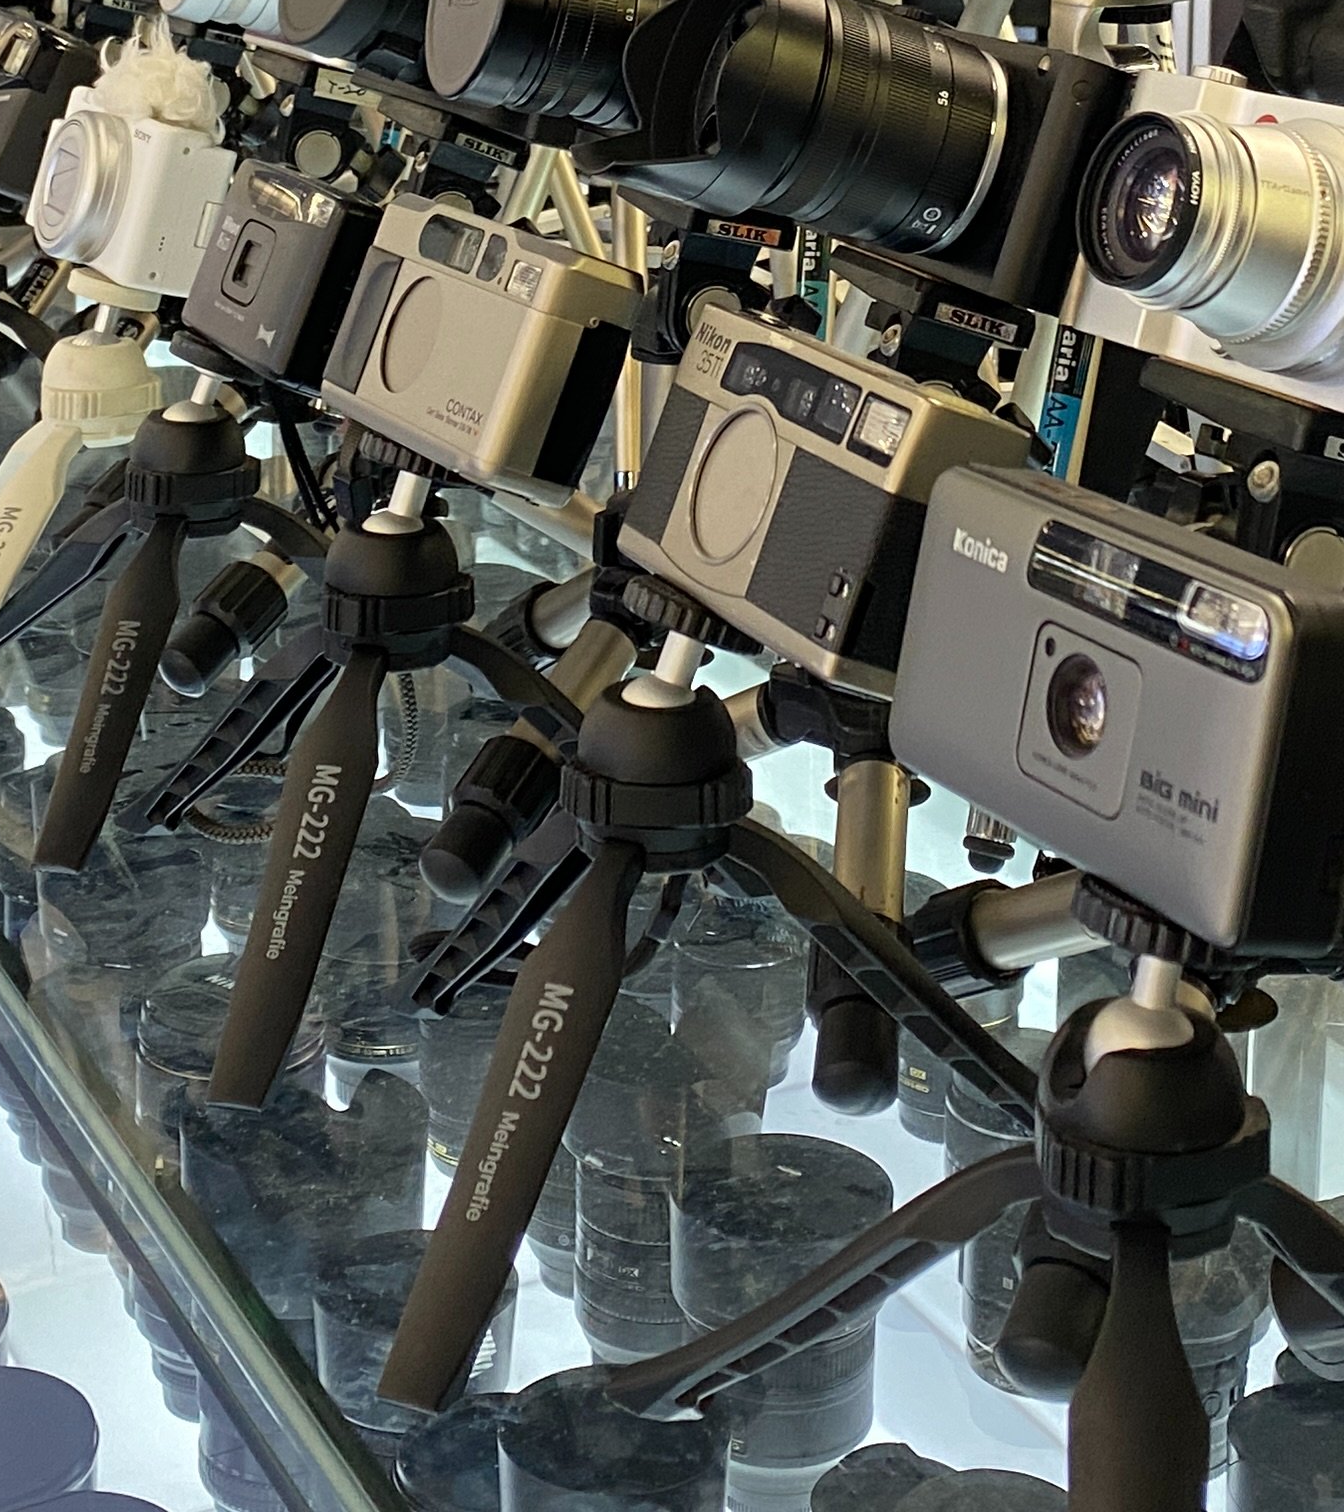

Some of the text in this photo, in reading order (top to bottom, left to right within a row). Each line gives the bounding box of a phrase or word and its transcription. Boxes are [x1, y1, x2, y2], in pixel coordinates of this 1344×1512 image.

[462, 137, 510, 164] SLIK
[718, 222, 770, 243] SLIK
[695, 320, 733, 353] Nikon
[949, 308, 1007, 336] SLIK
[1054, 328, 1078, 383] aria
[445, 398, 484, 426] CONTAX
[954, 527, 1009, 572] Konica
[77, 618, 143, 775] MG-222 Meingrafie
[264, 761, 344, 963] MG-222 Meingrafie
[464, 981, 576, 1225] MG-222 Meingrafie
